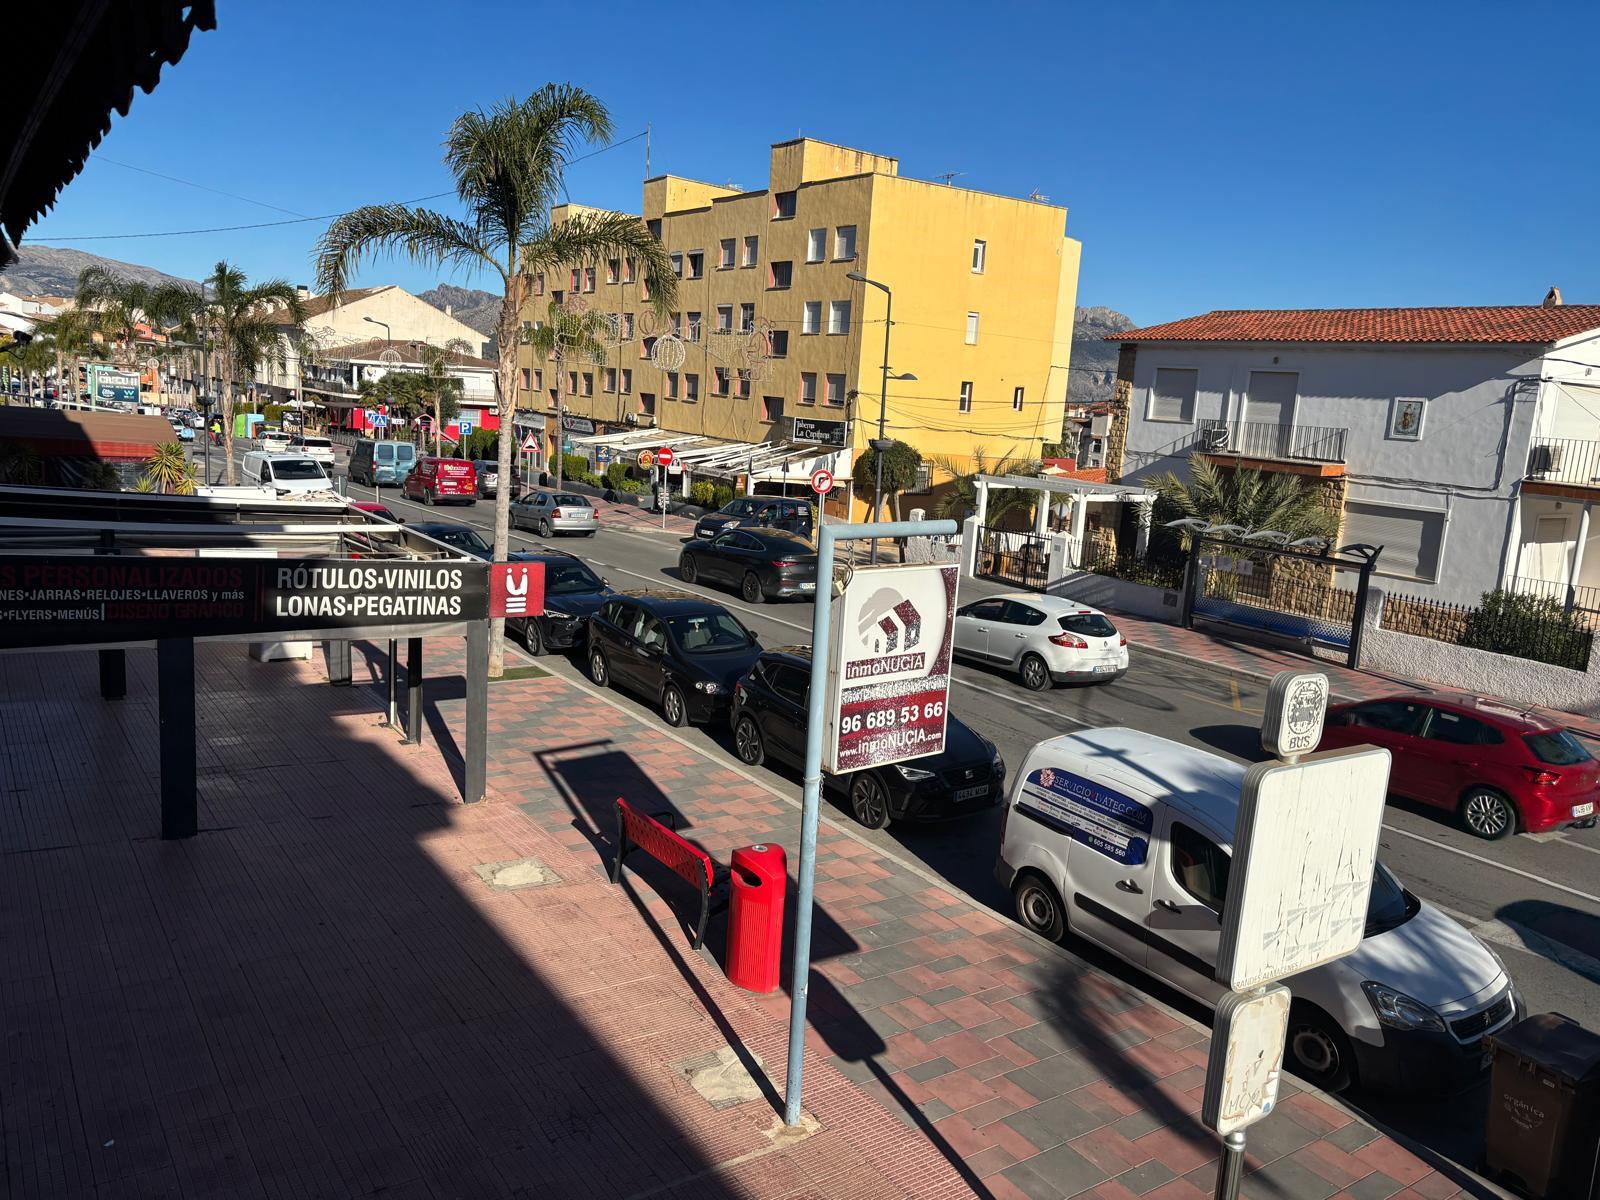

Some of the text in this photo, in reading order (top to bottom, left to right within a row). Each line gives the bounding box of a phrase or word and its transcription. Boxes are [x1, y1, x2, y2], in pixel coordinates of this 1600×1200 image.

[462, 424, 470, 434] P
[211, 590, 218, 602] y
[221, 588, 244, 601] más
[847, 655, 924, 679] inmoNUCIA
[841, 702, 943, 734] 96 689 53 66
[1289, 735, 1310, 749] BUS
[1093, 838, 1104, 848] 605
